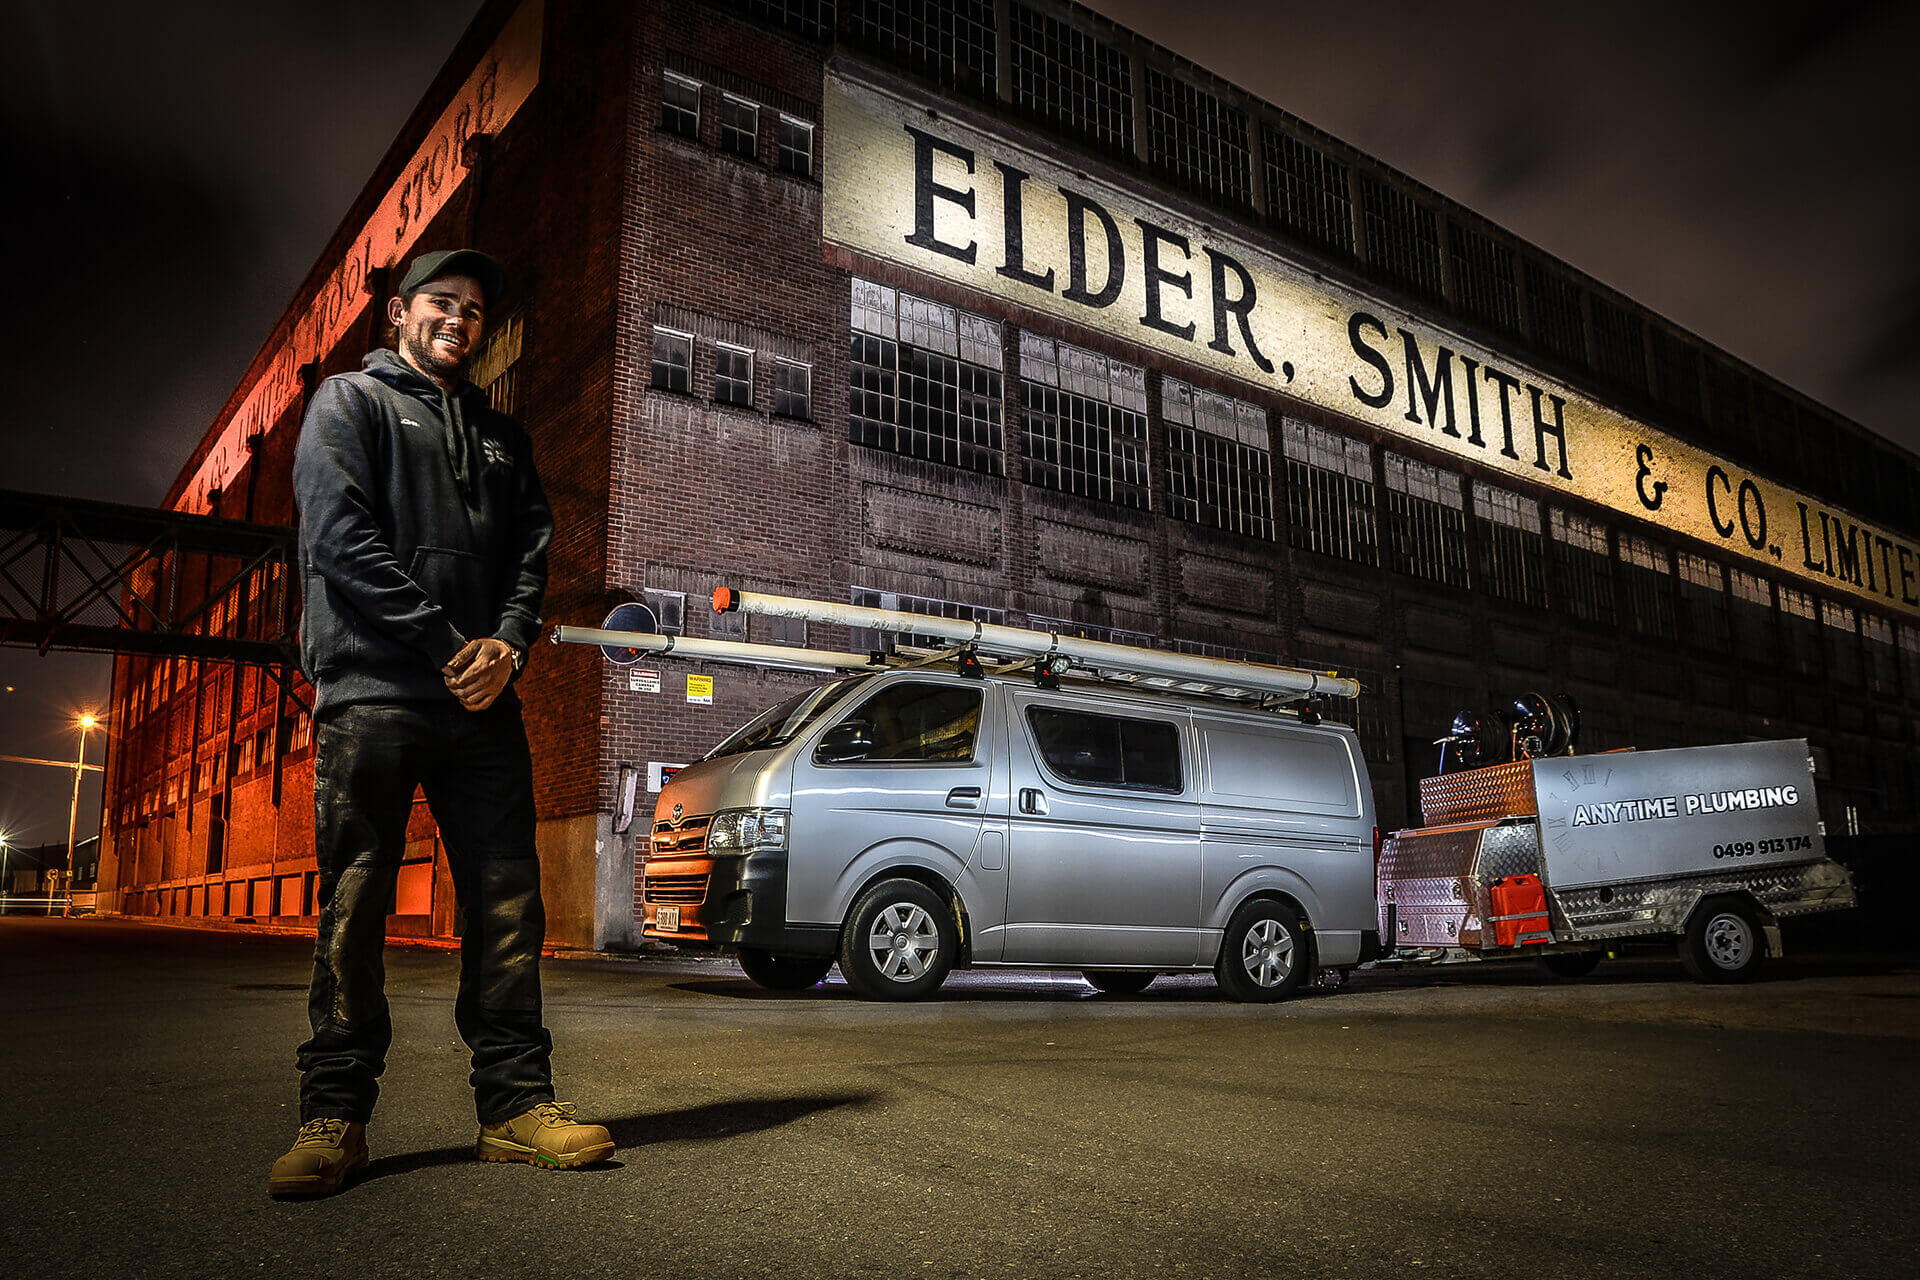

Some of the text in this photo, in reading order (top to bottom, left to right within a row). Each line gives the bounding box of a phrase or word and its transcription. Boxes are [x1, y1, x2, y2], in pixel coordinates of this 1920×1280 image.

[903, 124, 1296, 384] ELDER,
[1347, 312, 1573, 481] SMITH
[1634, 443, 1669, 512] &
[1795, 501, 1920, 607] LIMITE
[1573, 785, 1799, 827] ANYTIME PLUMBING
[1713, 835, 1812, 859] 0499 913 174
